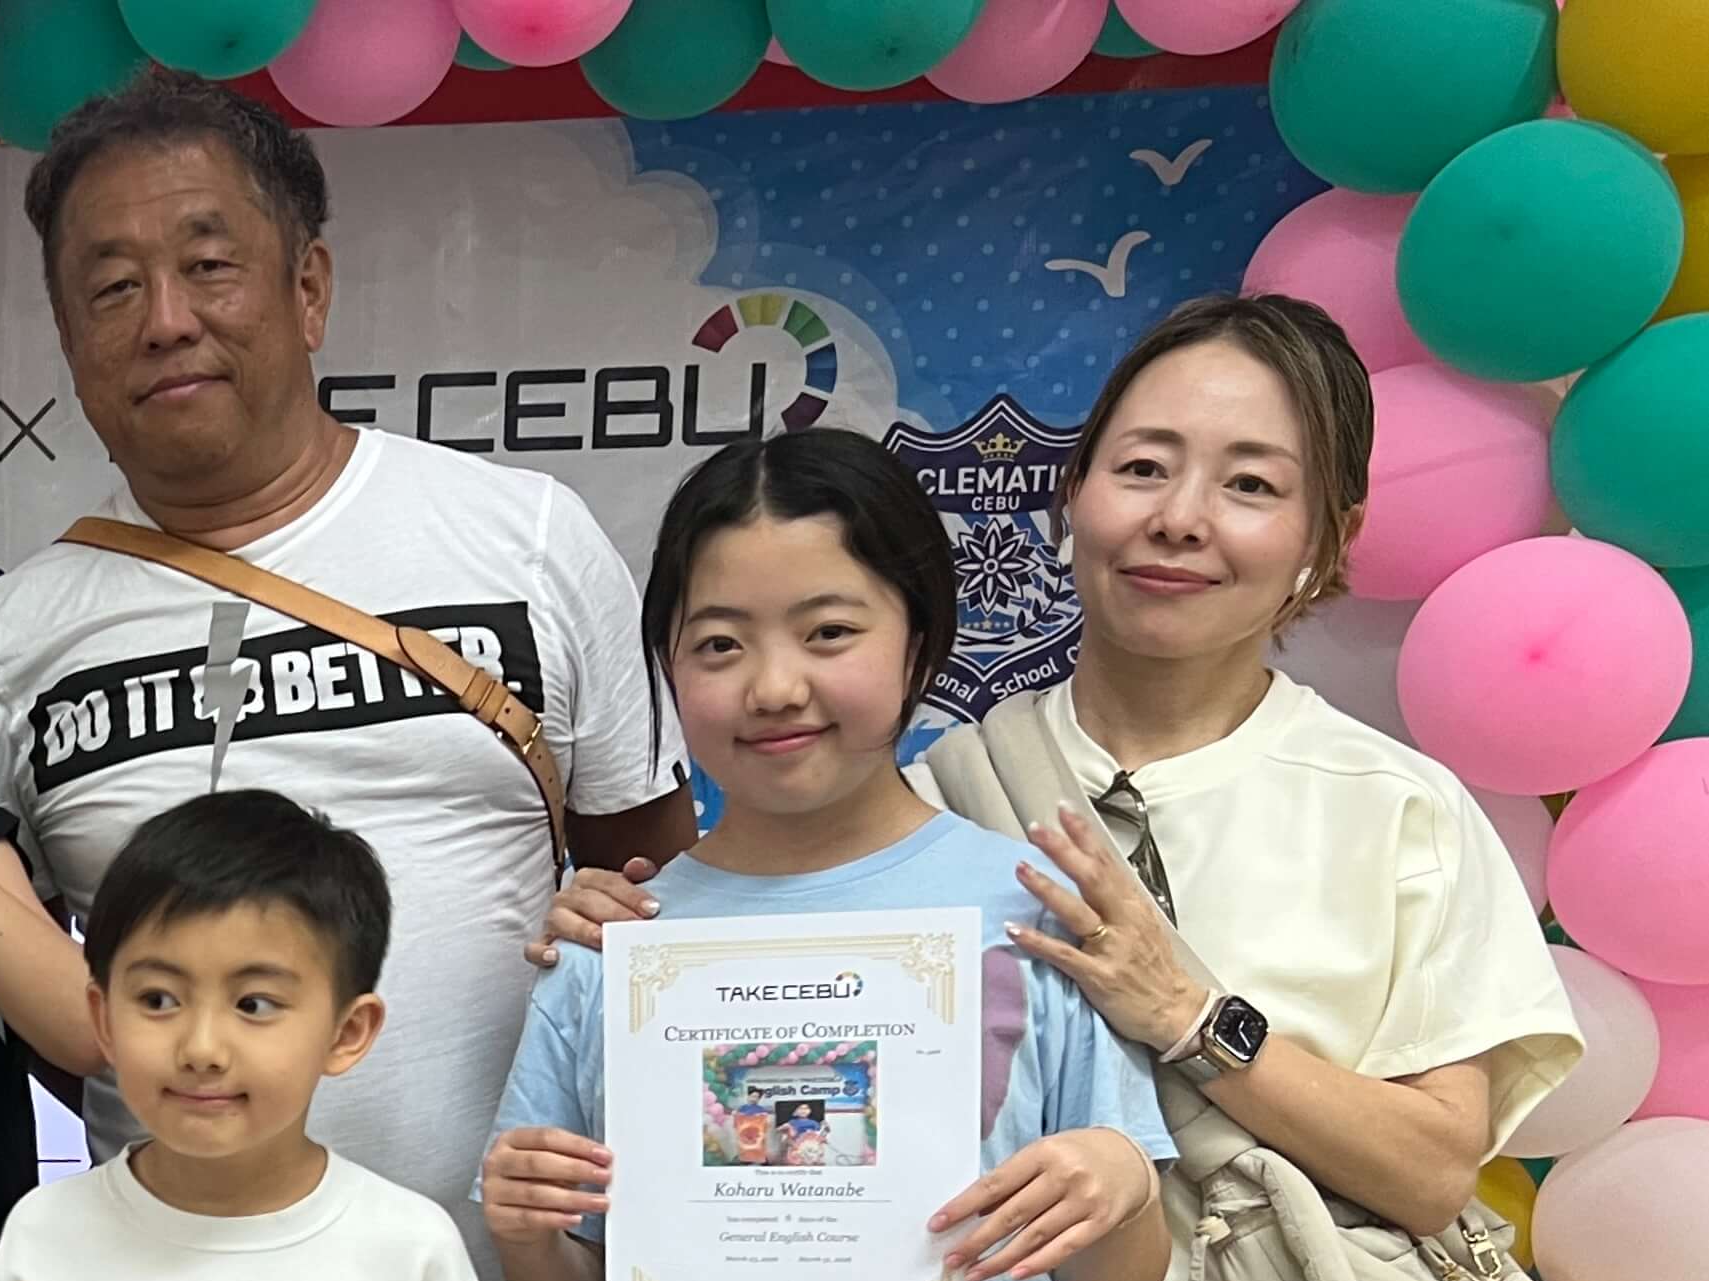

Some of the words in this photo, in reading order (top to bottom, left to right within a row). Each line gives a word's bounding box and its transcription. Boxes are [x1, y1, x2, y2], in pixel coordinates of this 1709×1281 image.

[916, 464, 1066, 496] CLEMATI
[971, 495, 1020, 512] CEBU
[991, 658, 1060, 700] School
[43, 690, 111, 766] DO
[124, 669, 180, 740] IT
[714, 1181, 774, 1198] Koharu
[780, 1181, 865, 1198] Watanabe
